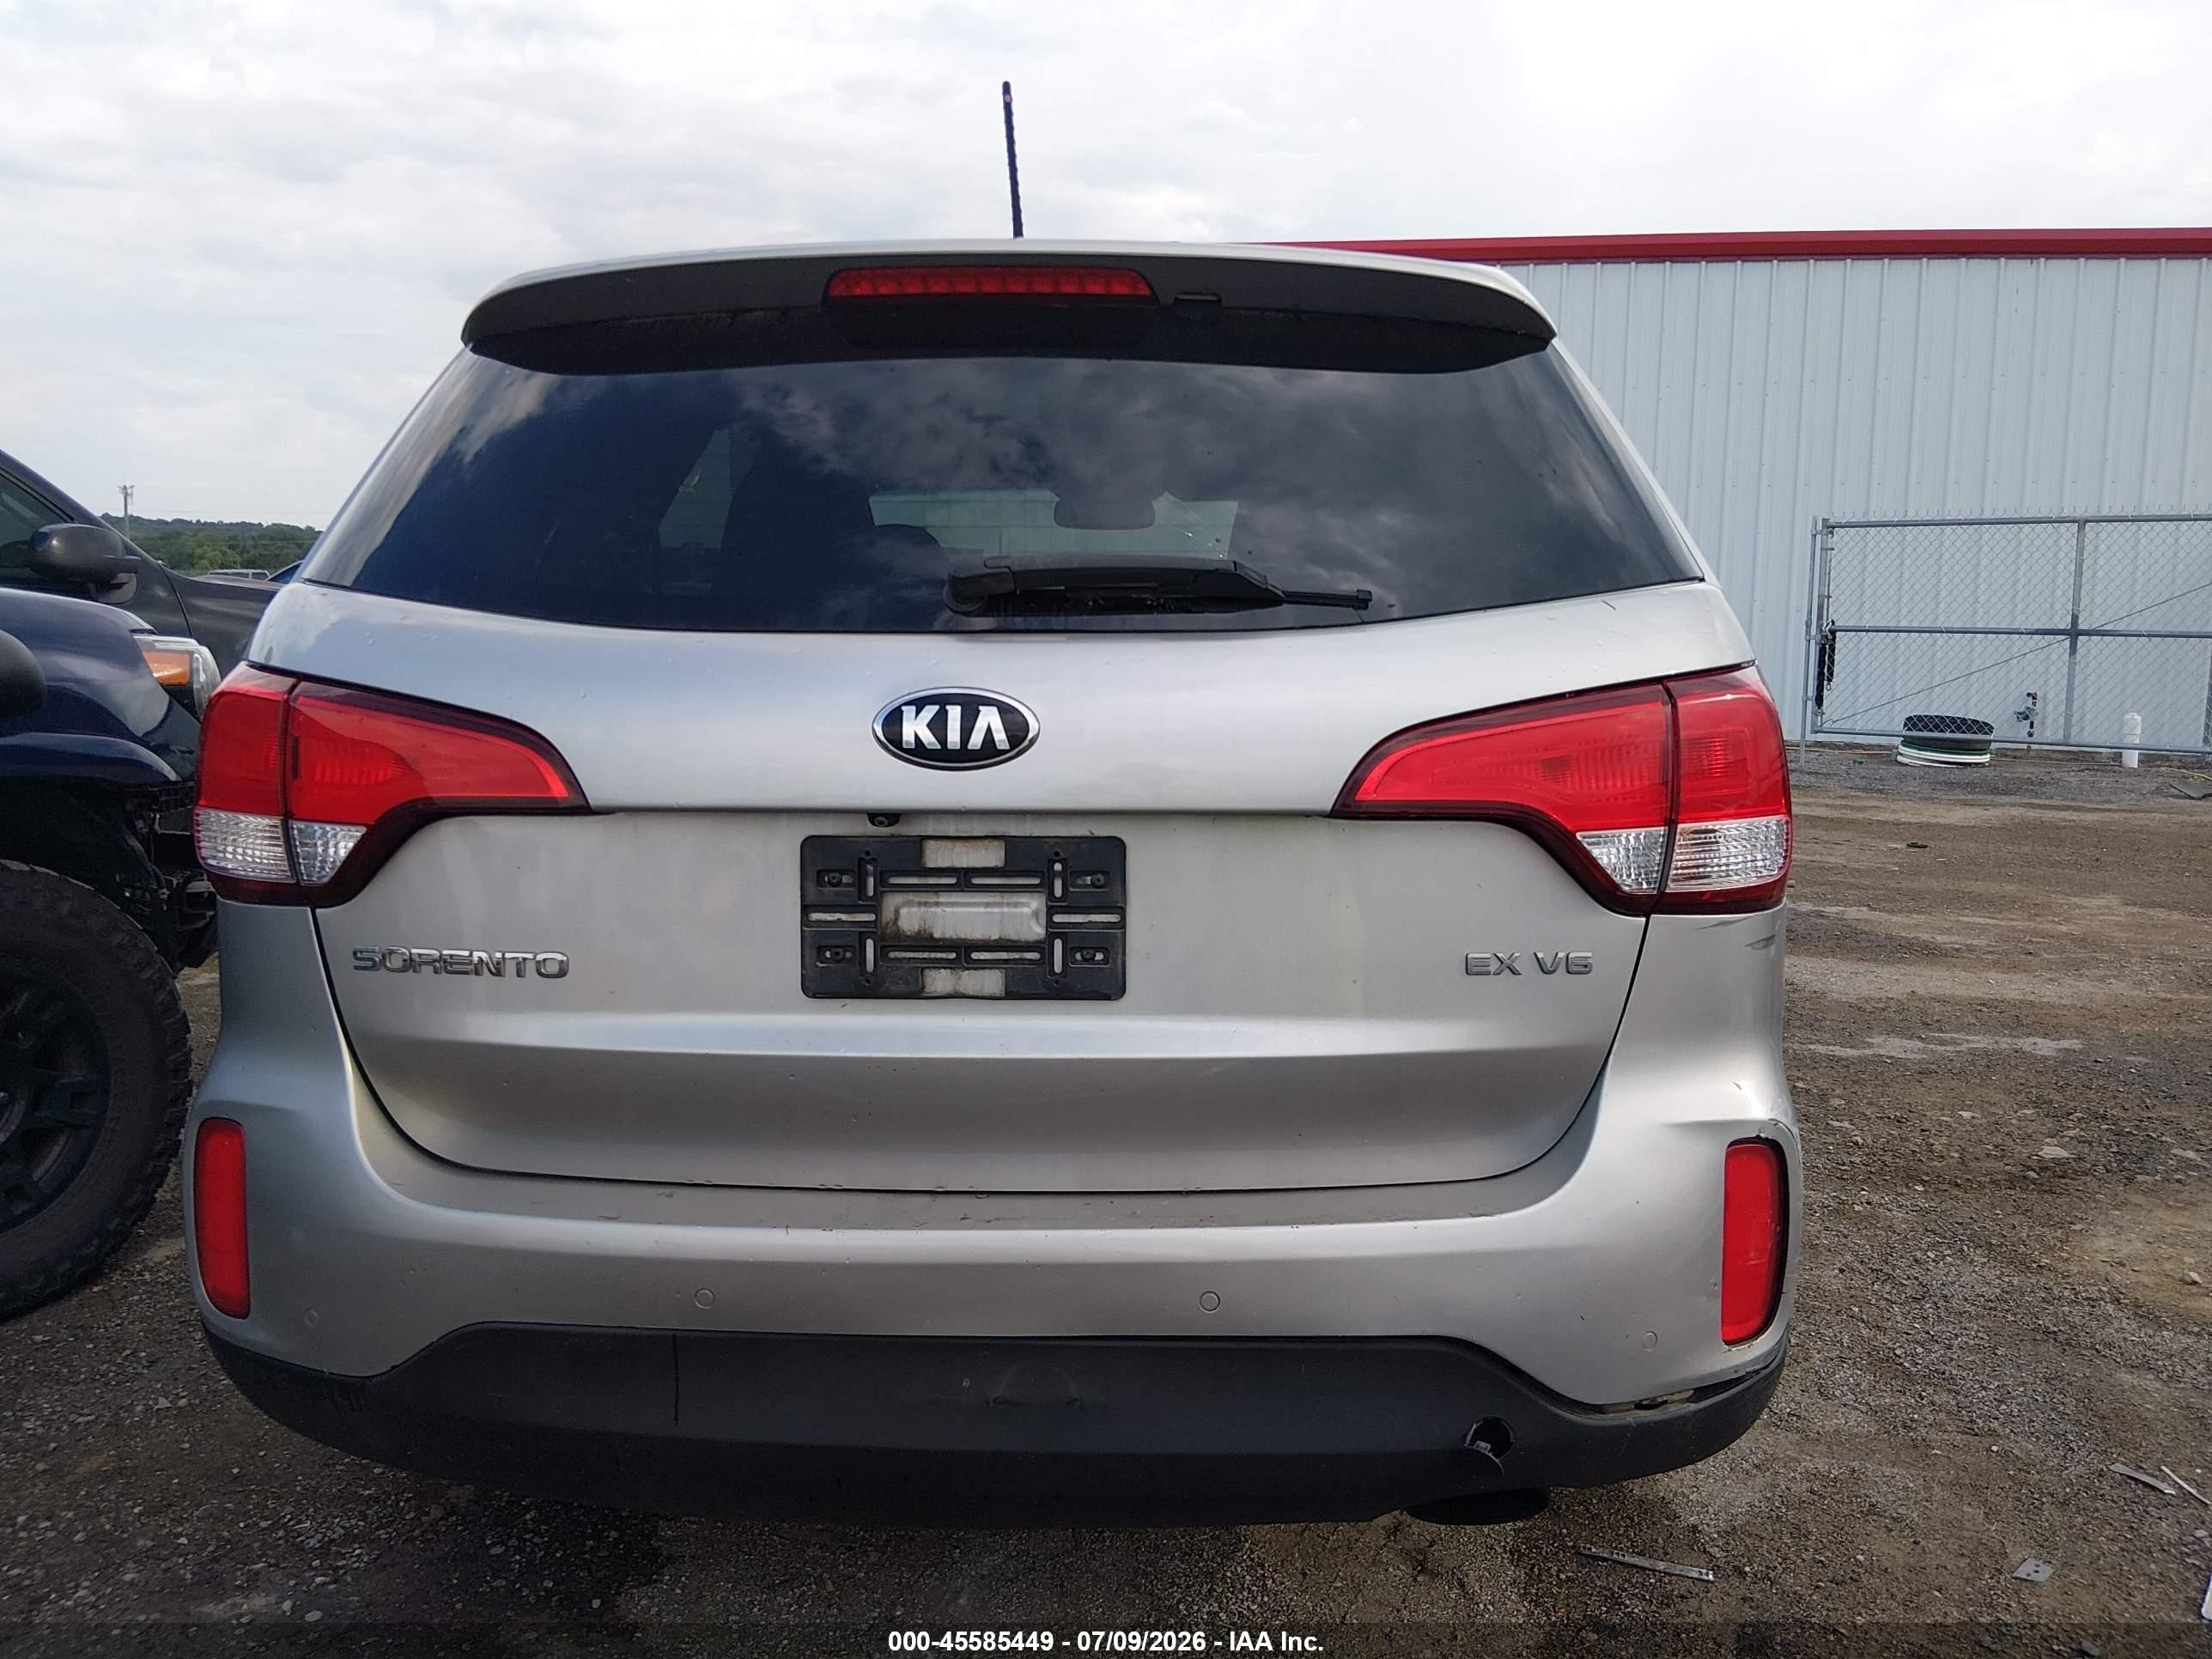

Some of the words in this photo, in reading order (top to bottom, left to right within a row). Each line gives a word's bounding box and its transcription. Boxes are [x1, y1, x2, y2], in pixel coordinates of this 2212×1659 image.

[901, 705, 1011, 750] KIA
[352, 945, 570, 979] SORENTO
[1465, 951, 1522, 975] EX
[1533, 951, 1593, 975] V6
